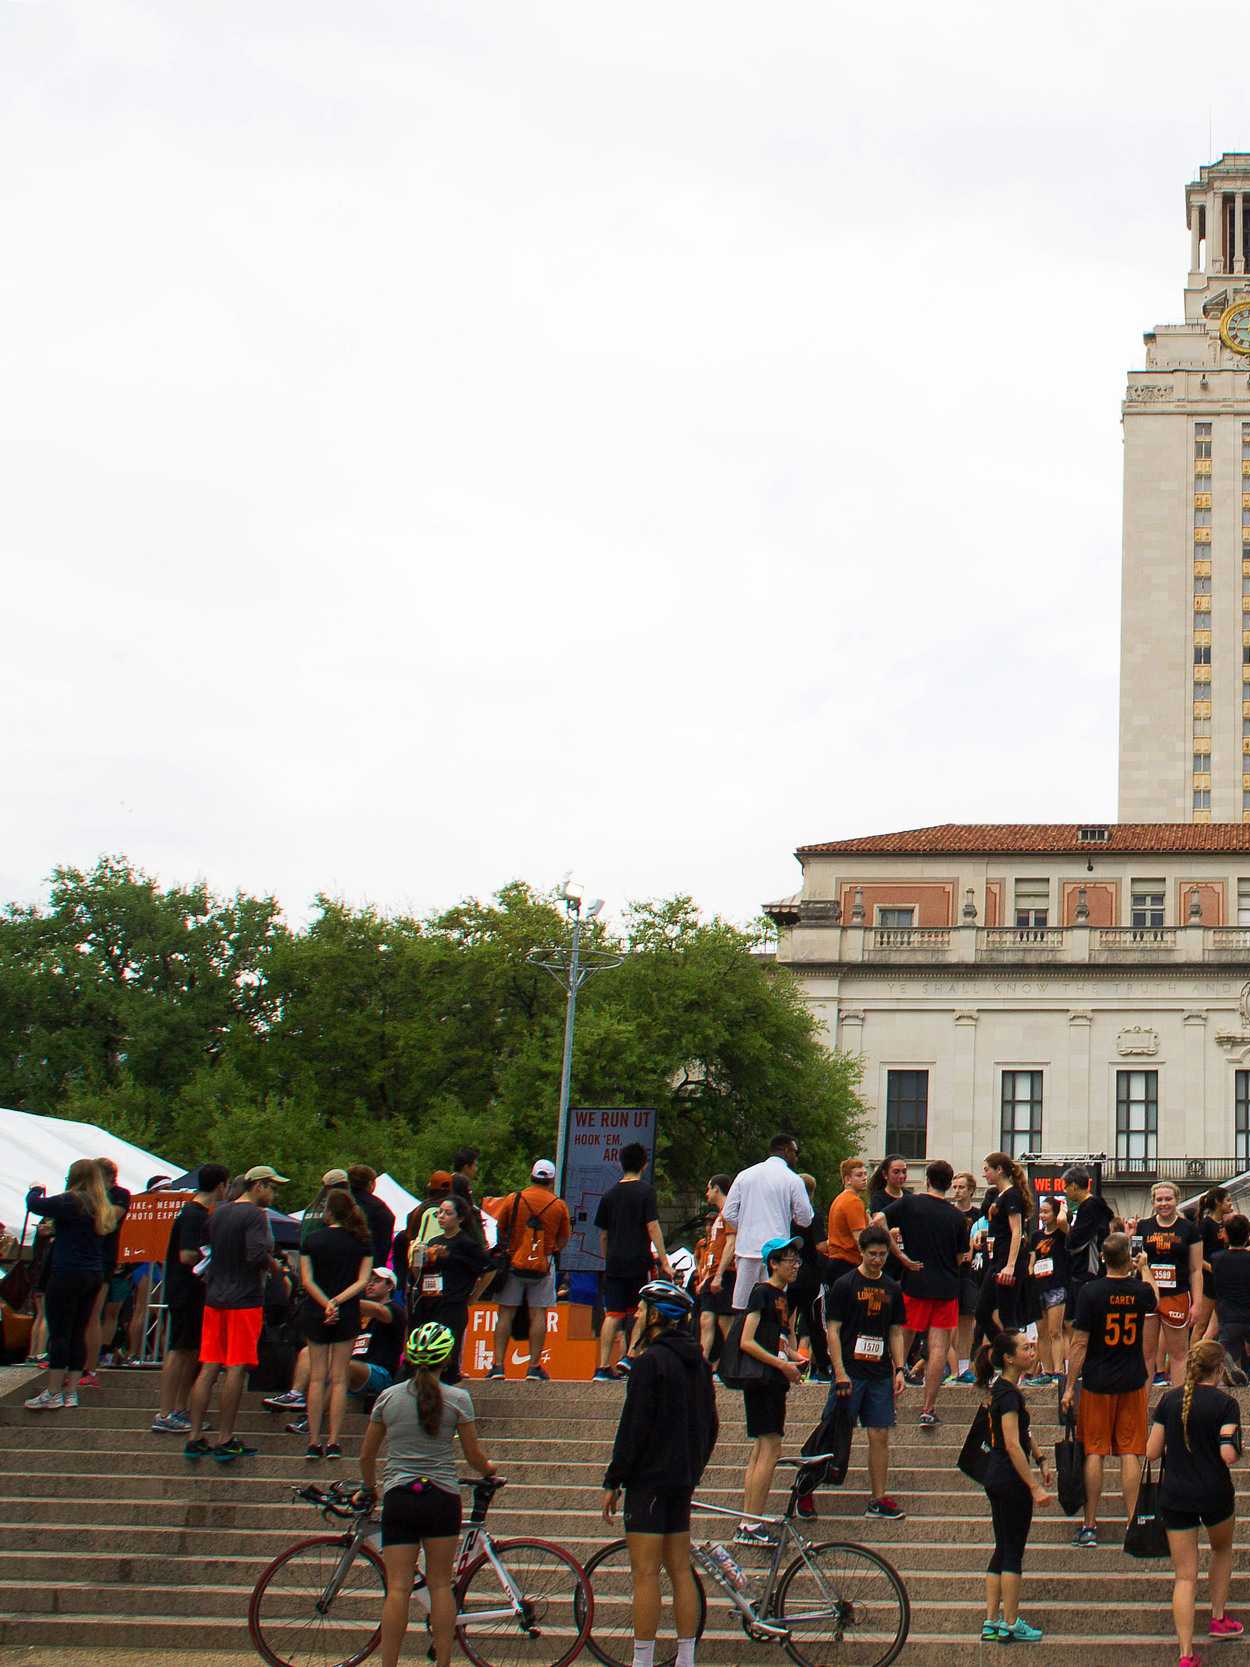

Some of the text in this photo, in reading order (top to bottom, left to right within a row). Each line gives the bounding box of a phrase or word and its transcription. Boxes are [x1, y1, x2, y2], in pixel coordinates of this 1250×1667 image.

[887, 984, 907, 993] YE
[922, 984, 979, 993] SHALL
[993, 984, 1049, 993] KNOW
[1063, 984, 1097, 993] THE
[1112, 983, 1177, 993] TRUTH
[1191, 983, 1231, 993] AND
[576, 1112, 651, 1127] WE RUN UT
[574, 1134, 600, 1145] HOOK
[1035, 1178, 1050, 1193] WE
[126, 1212, 153, 1220] PHOTO
[1109, 1295, 1135, 1305] CAREY
[1104, 1313, 1138, 1346] 55
[863, 1341, 880, 1353] 1570
